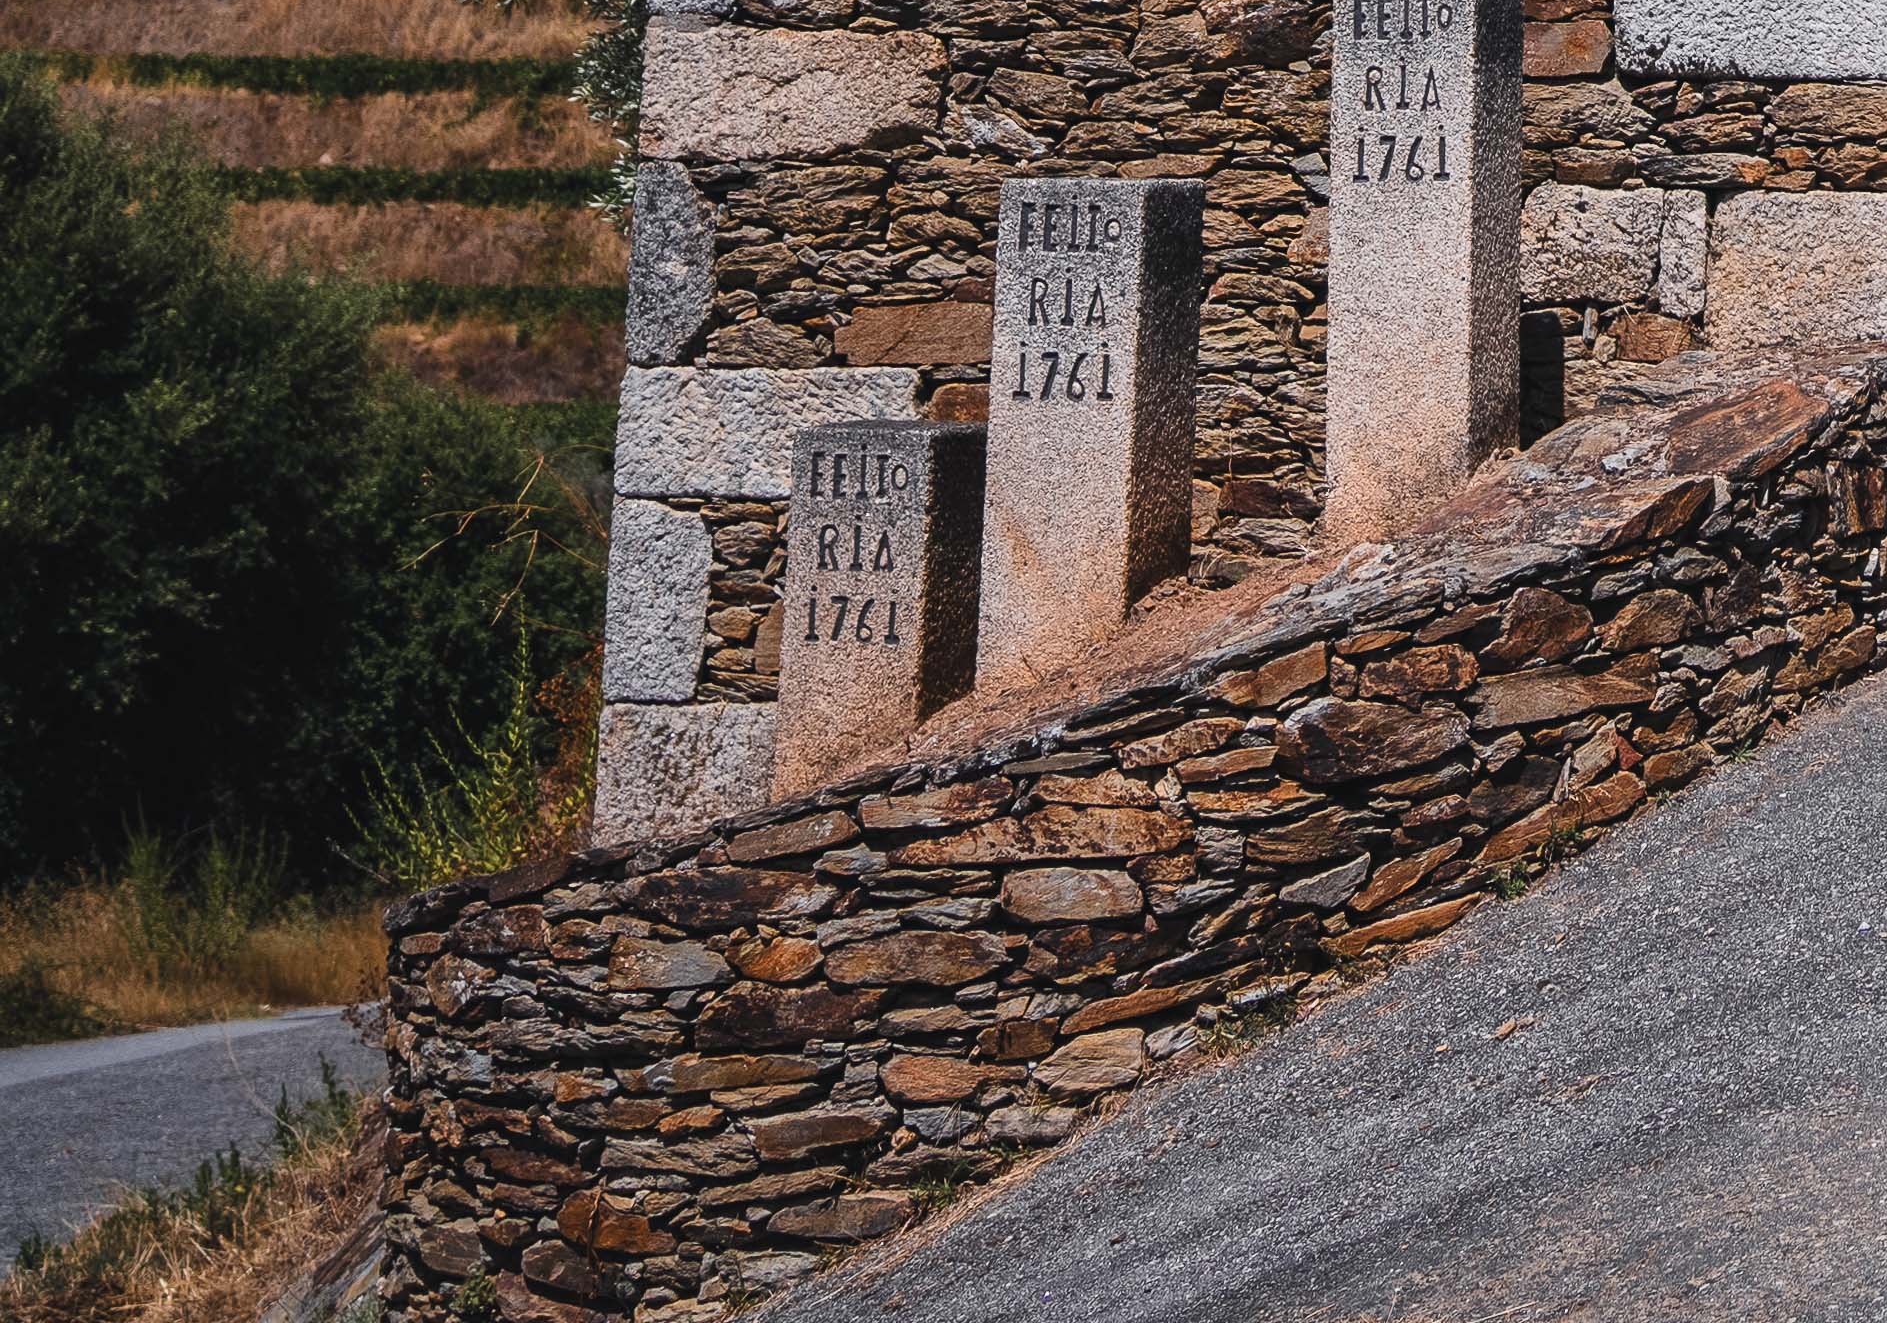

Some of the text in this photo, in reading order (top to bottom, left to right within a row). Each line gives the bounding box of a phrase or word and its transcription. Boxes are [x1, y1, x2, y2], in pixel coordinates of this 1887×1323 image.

[1364, 57, 1441, 111] RIA
[1352, 125, 1451, 183] 1761
[1028, 267, 1106, 326] RIA
[1012, 341, 1114, 402] 1761
[818, 514, 894, 571] RIA
[804, 585, 900, 644] 1761
